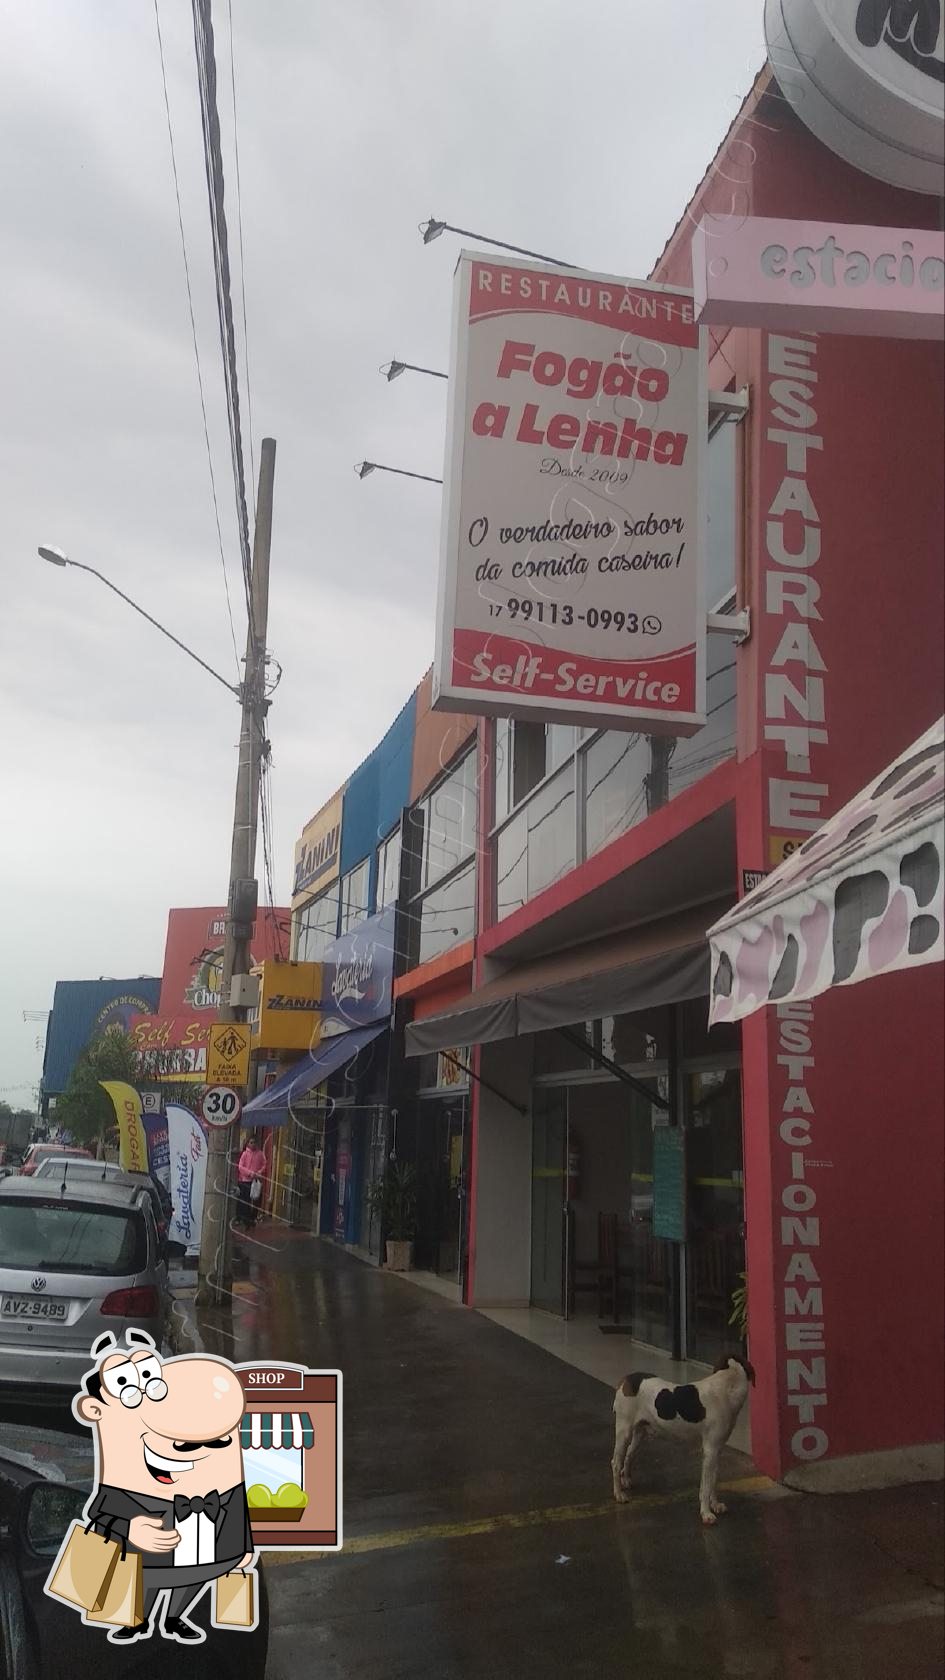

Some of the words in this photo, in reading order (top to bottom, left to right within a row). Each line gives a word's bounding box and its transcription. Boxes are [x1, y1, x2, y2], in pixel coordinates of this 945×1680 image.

[478, 269, 693, 325] RESTAURANTE
[497, 339, 670, 403] Fogão
[472, 402, 510, 438] a
[516, 403, 688, 466] Lenha
[539, 457, 585, 478] Desde
[588, 468, 629, 484] 2009
[468, 516, 489, 547] O
[500, 518, 616, 545] verdadeiro
[623, 512, 685, 537] sabor
[475, 558, 502, 582] da
[511, 552, 589, 579] comida
[597, 542, 686, 573] caseira!
[764, 331, 829, 830] ESTAURANTE
[488, 604, 503, 617] 17
[507, 598, 639, 634] 99113-0993
[470, 652, 681, 704] Self-Service
[134, 1020, 175, 1047] Self
[207, 1092, 236, 1115] 30
[176, 1153, 191, 1240] Lavateria
